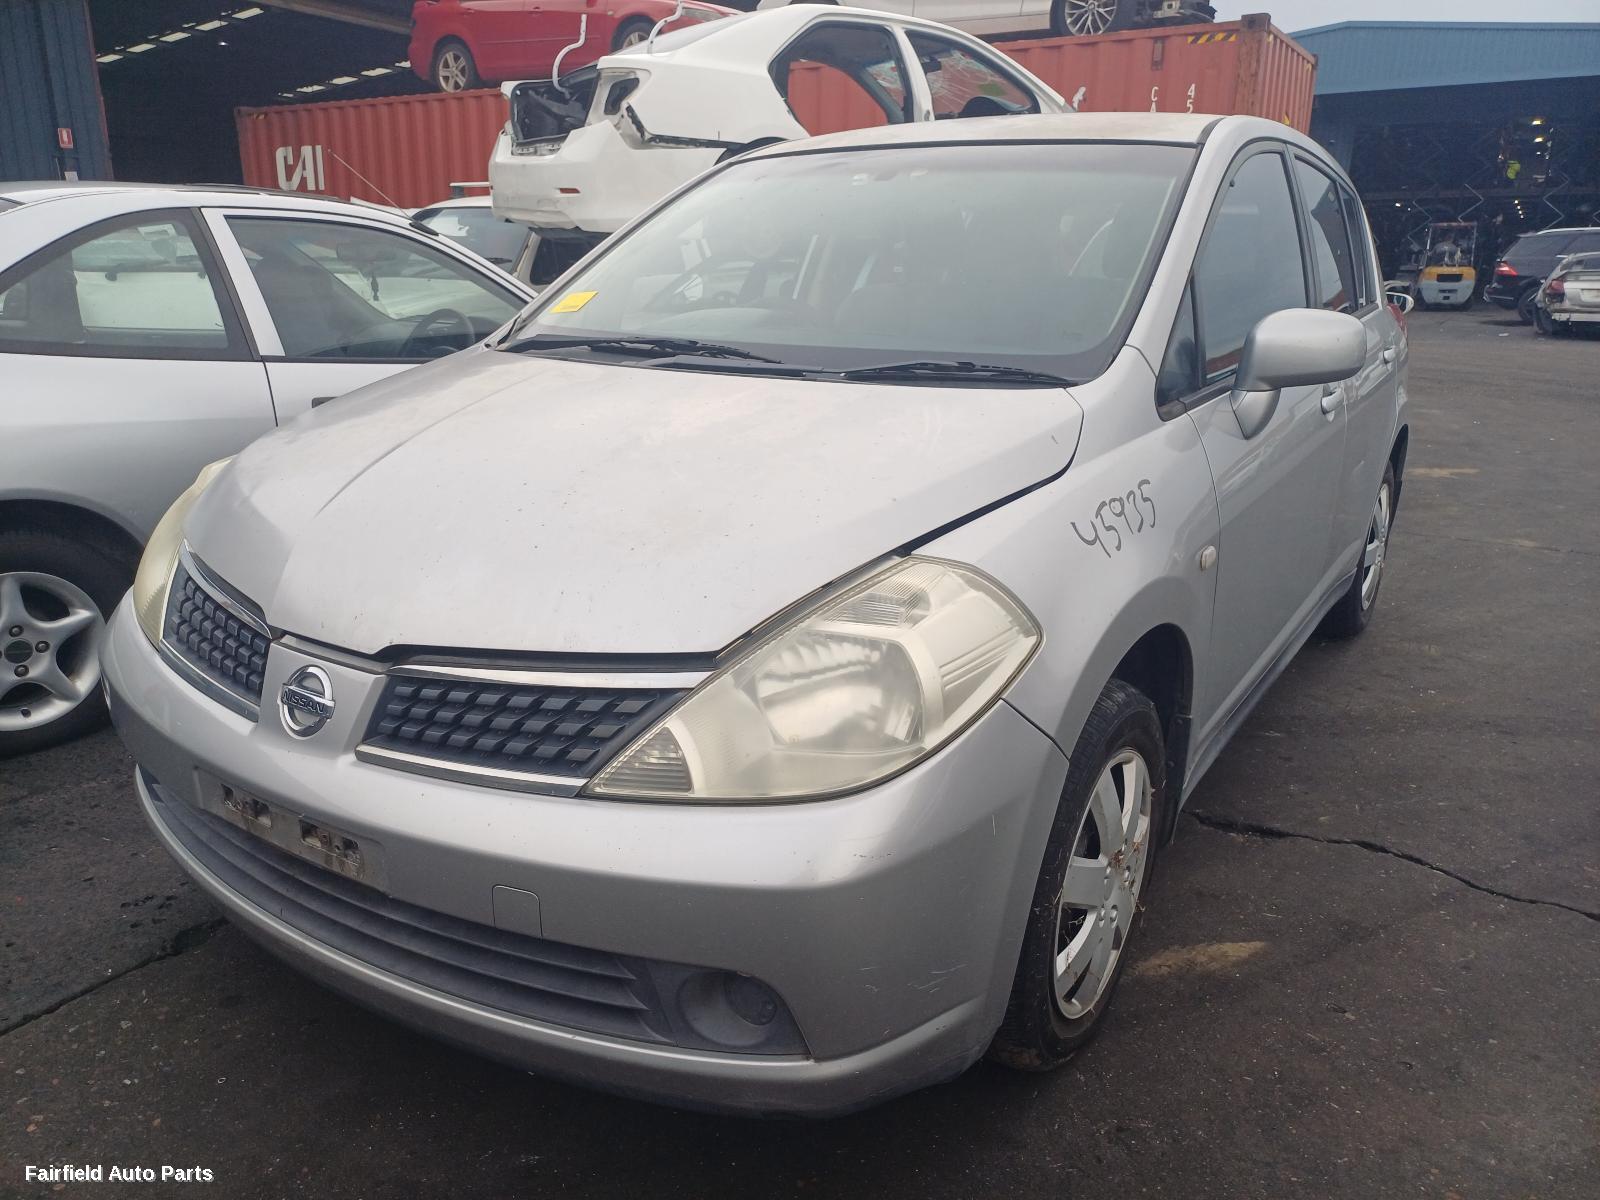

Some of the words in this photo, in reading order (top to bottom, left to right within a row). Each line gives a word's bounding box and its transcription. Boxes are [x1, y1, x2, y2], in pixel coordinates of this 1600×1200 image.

[275, 145, 325, 191] CAI
[1070, 479, 1156, 558] 45935
[283, 688, 326, 714] NISSAN
